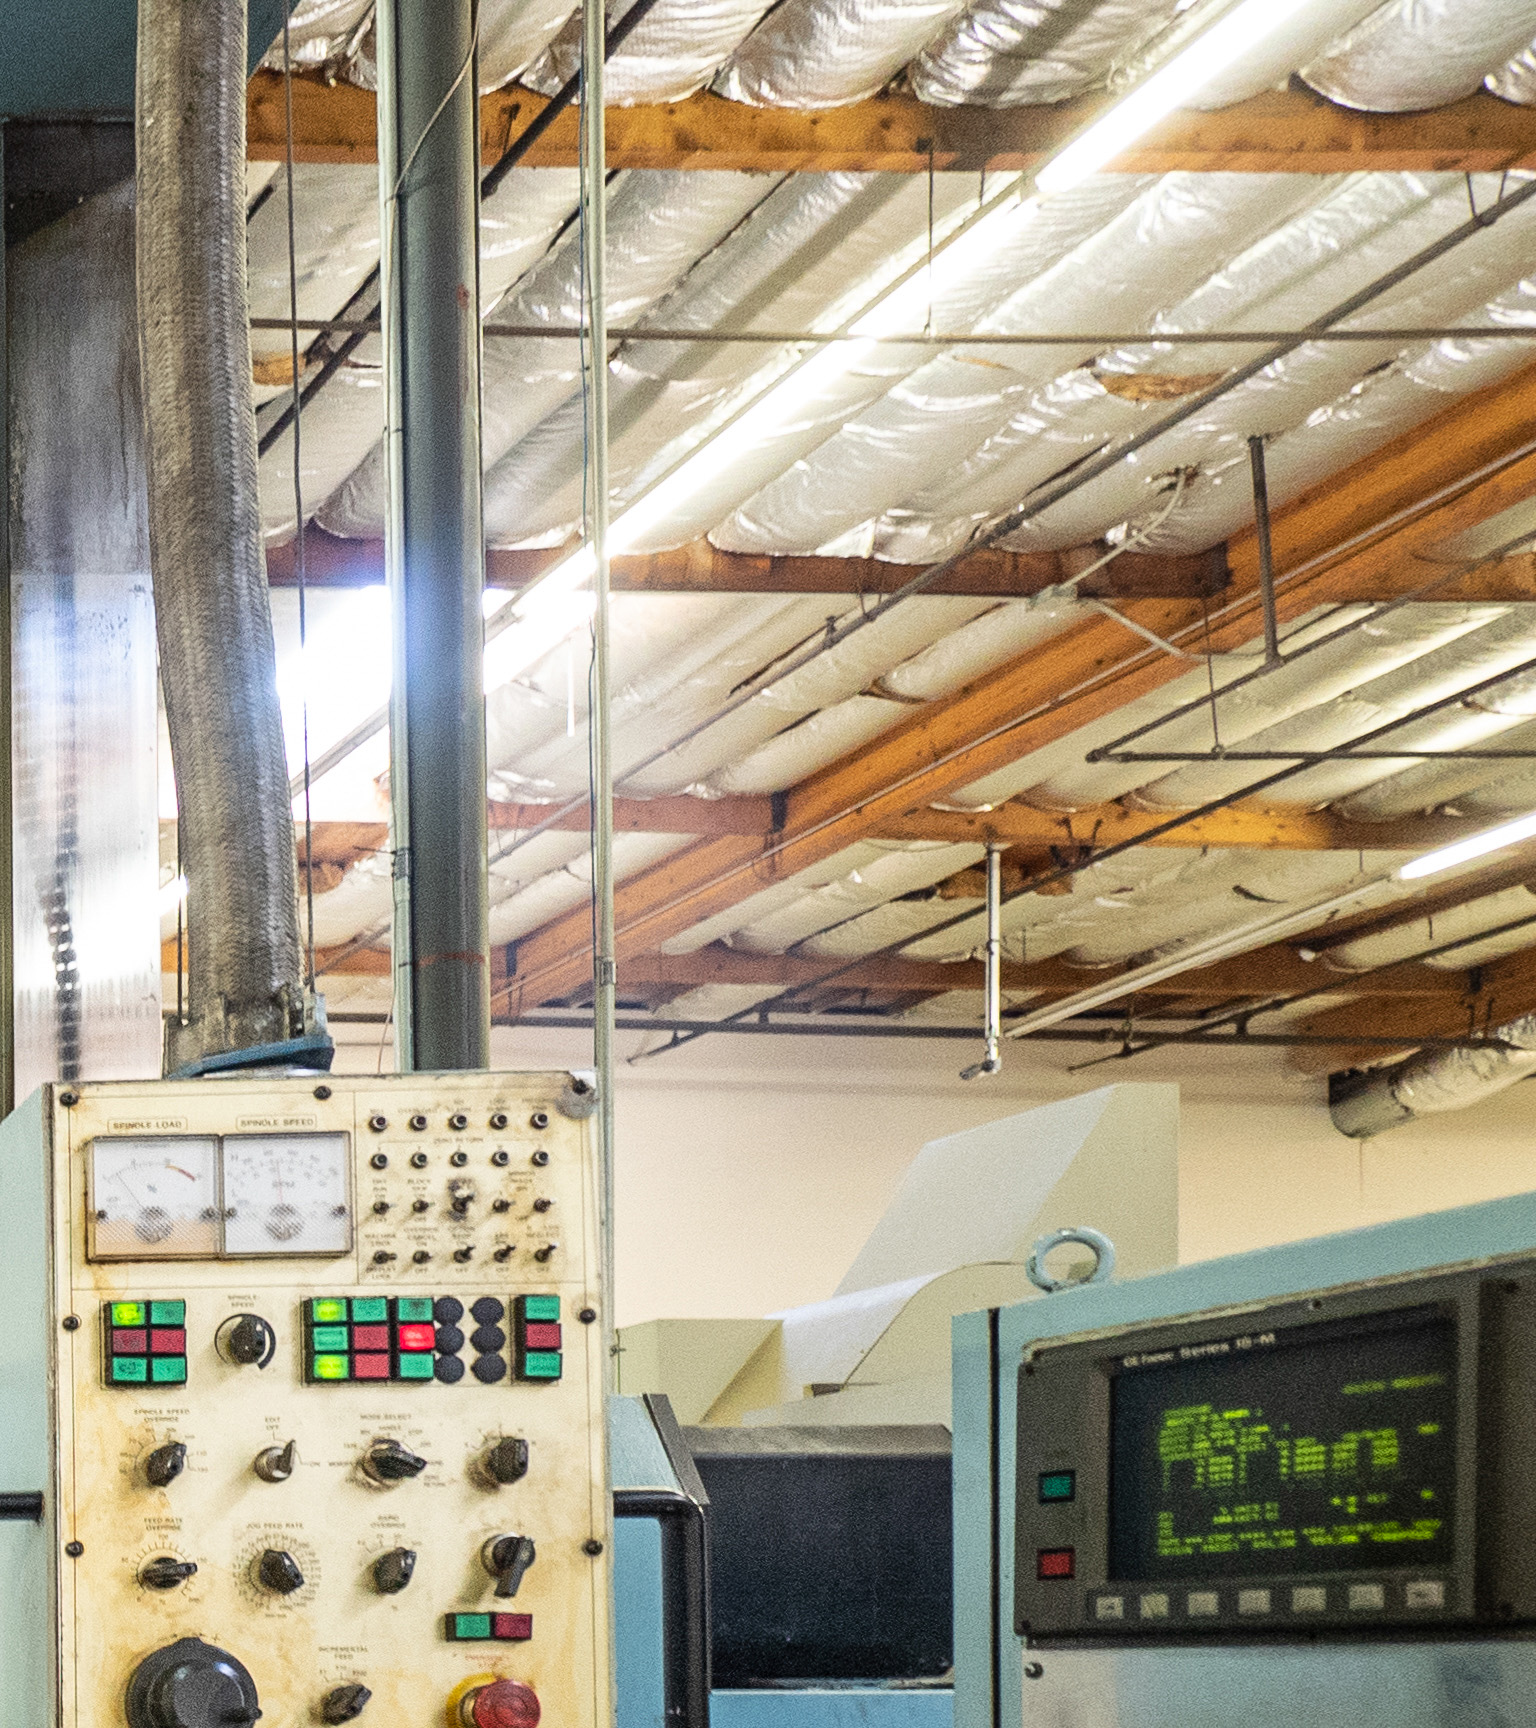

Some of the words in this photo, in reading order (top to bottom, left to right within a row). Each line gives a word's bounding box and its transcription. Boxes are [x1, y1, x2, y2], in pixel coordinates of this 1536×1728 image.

[113, 1121, 151, 1130] SPINDLE
[156, 1120, 182, 1129] LOAD
[240, 1118, 278, 1127] SPINDLE
[282, 1117, 314, 1127] SPEED
